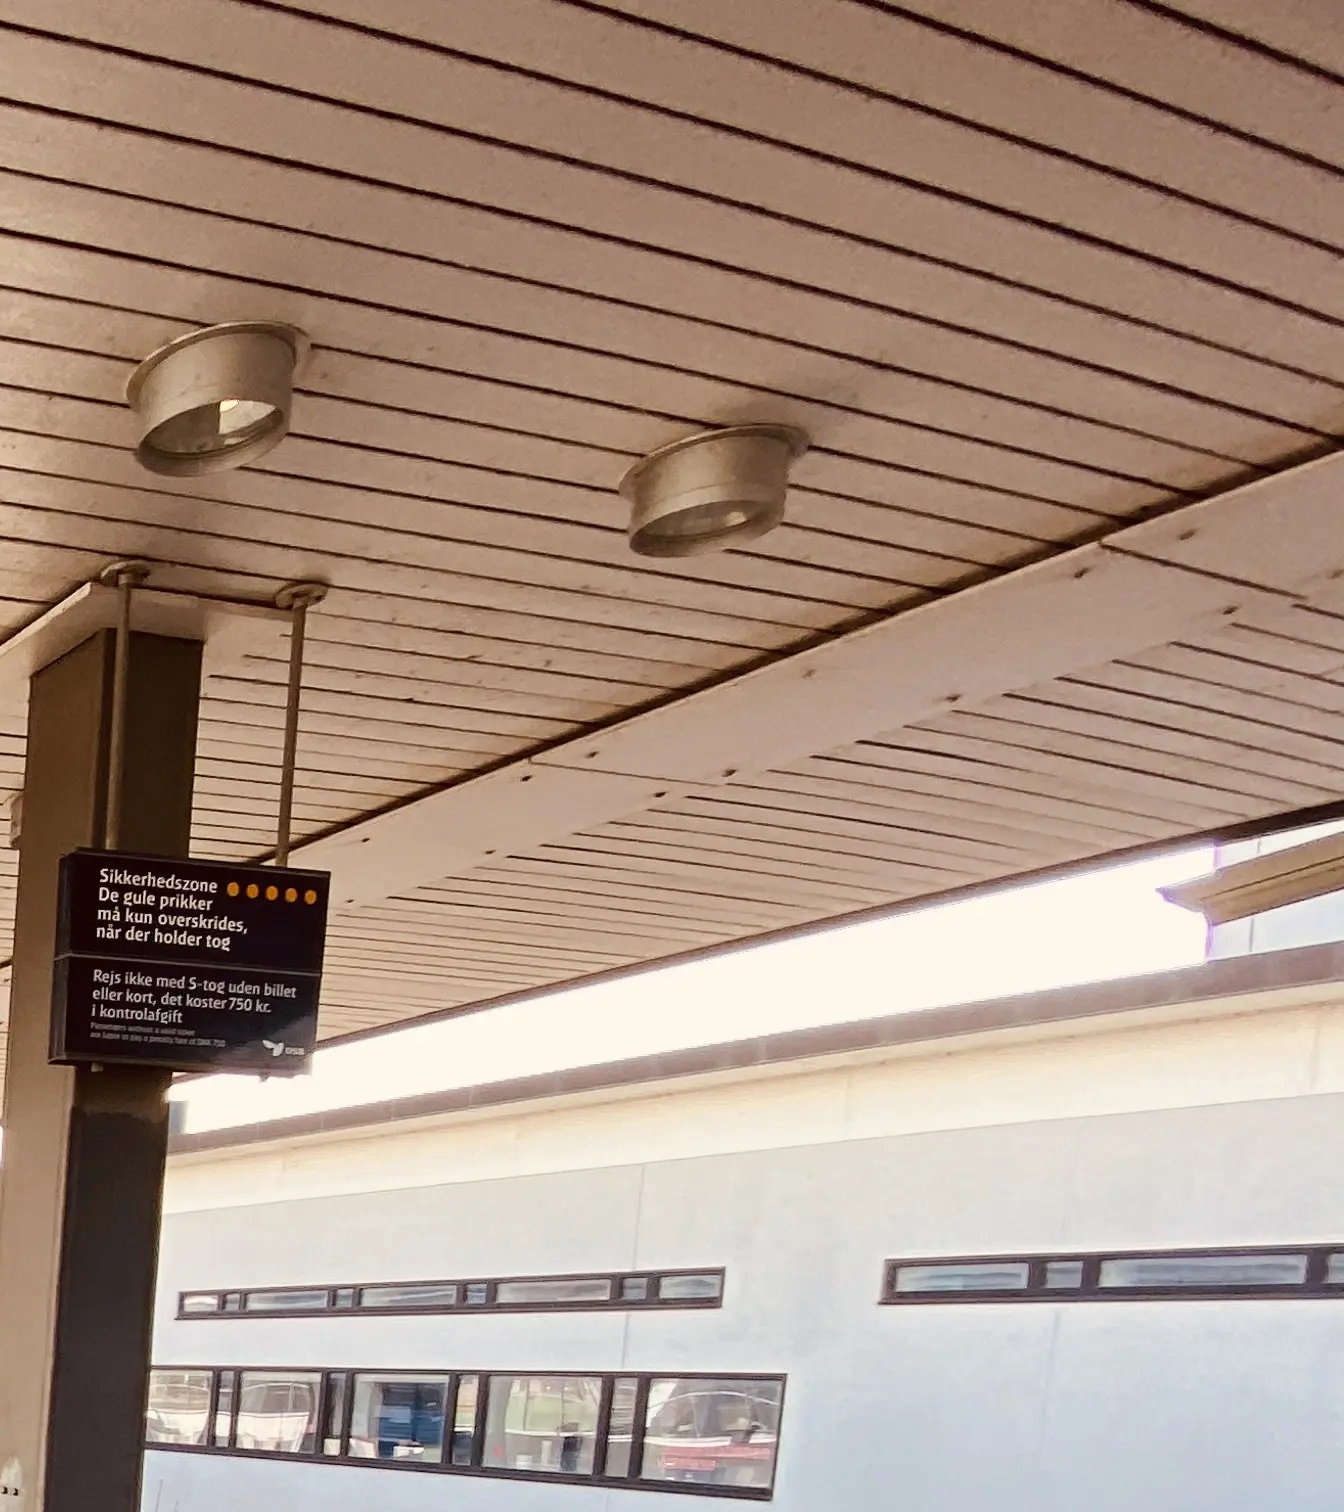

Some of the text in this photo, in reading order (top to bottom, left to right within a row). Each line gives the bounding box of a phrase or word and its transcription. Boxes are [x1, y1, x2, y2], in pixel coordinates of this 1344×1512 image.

[99, 868, 218, 894] Sikkerhedszone
[98, 887, 213, 911] De gule prikker
[97, 906, 248, 934] må kun overskrides,
[96, 924, 231, 951] når der holder tog
[93, 969, 297, 998] Rejs ikke med S-tog uden billet
[92, 986, 272, 1013] eller kort, det koster 750 kr.
[91, 1003, 183, 1024] i kontrolafgift
